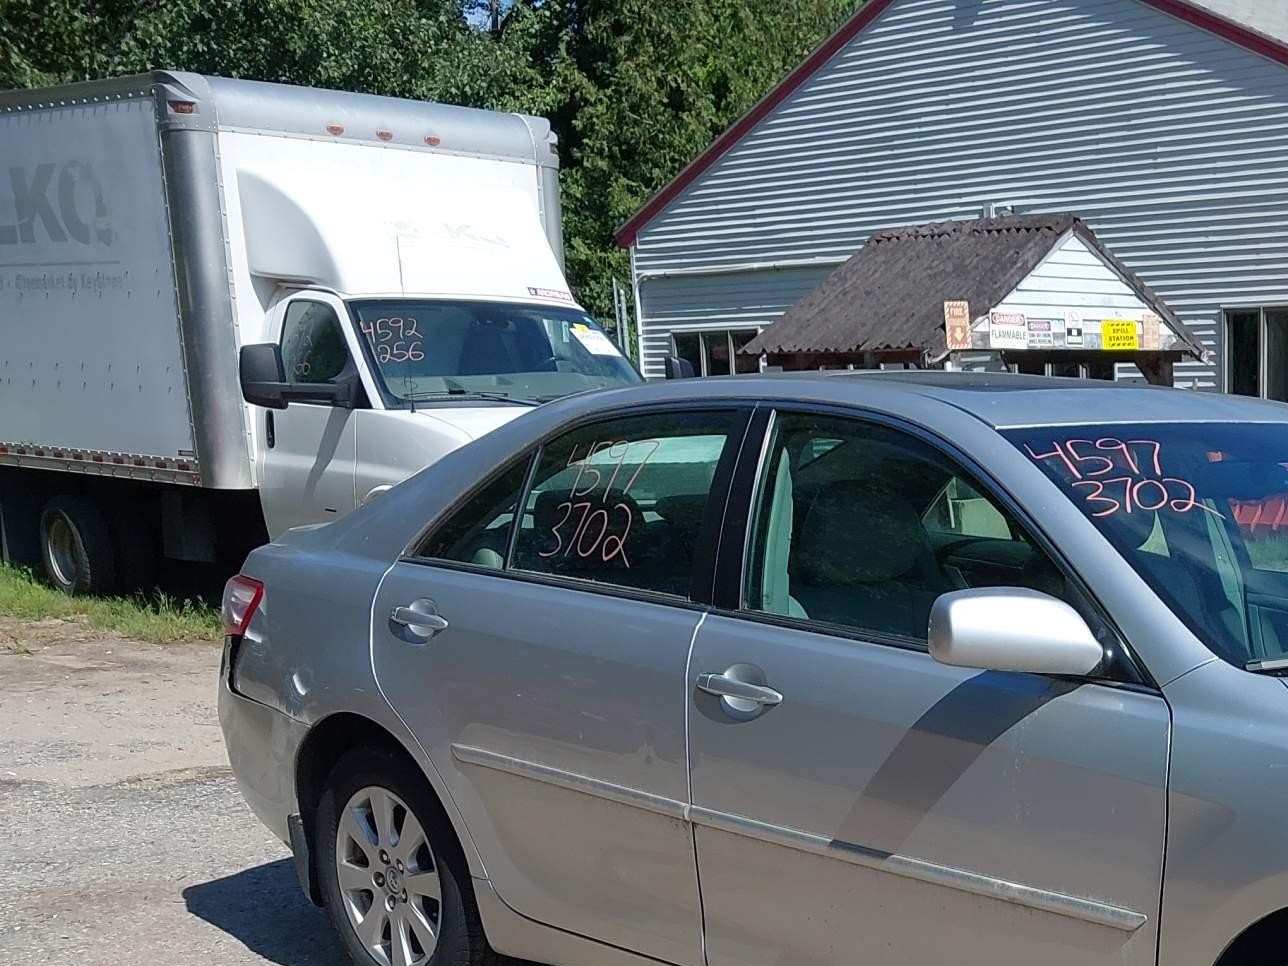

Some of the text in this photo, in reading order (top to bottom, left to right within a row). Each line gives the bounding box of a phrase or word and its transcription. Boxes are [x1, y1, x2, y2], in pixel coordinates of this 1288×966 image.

[359, 317, 424, 343] 4592
[991, 329, 1027, 341] FLAMMABLE
[377, 341, 425, 363] 256
[566, 440, 660, 504] 4597
[1023, 438, 1162, 479] 4597
[1071, 477, 1227, 517] 3702
[538, 502, 631, 569] 3702
